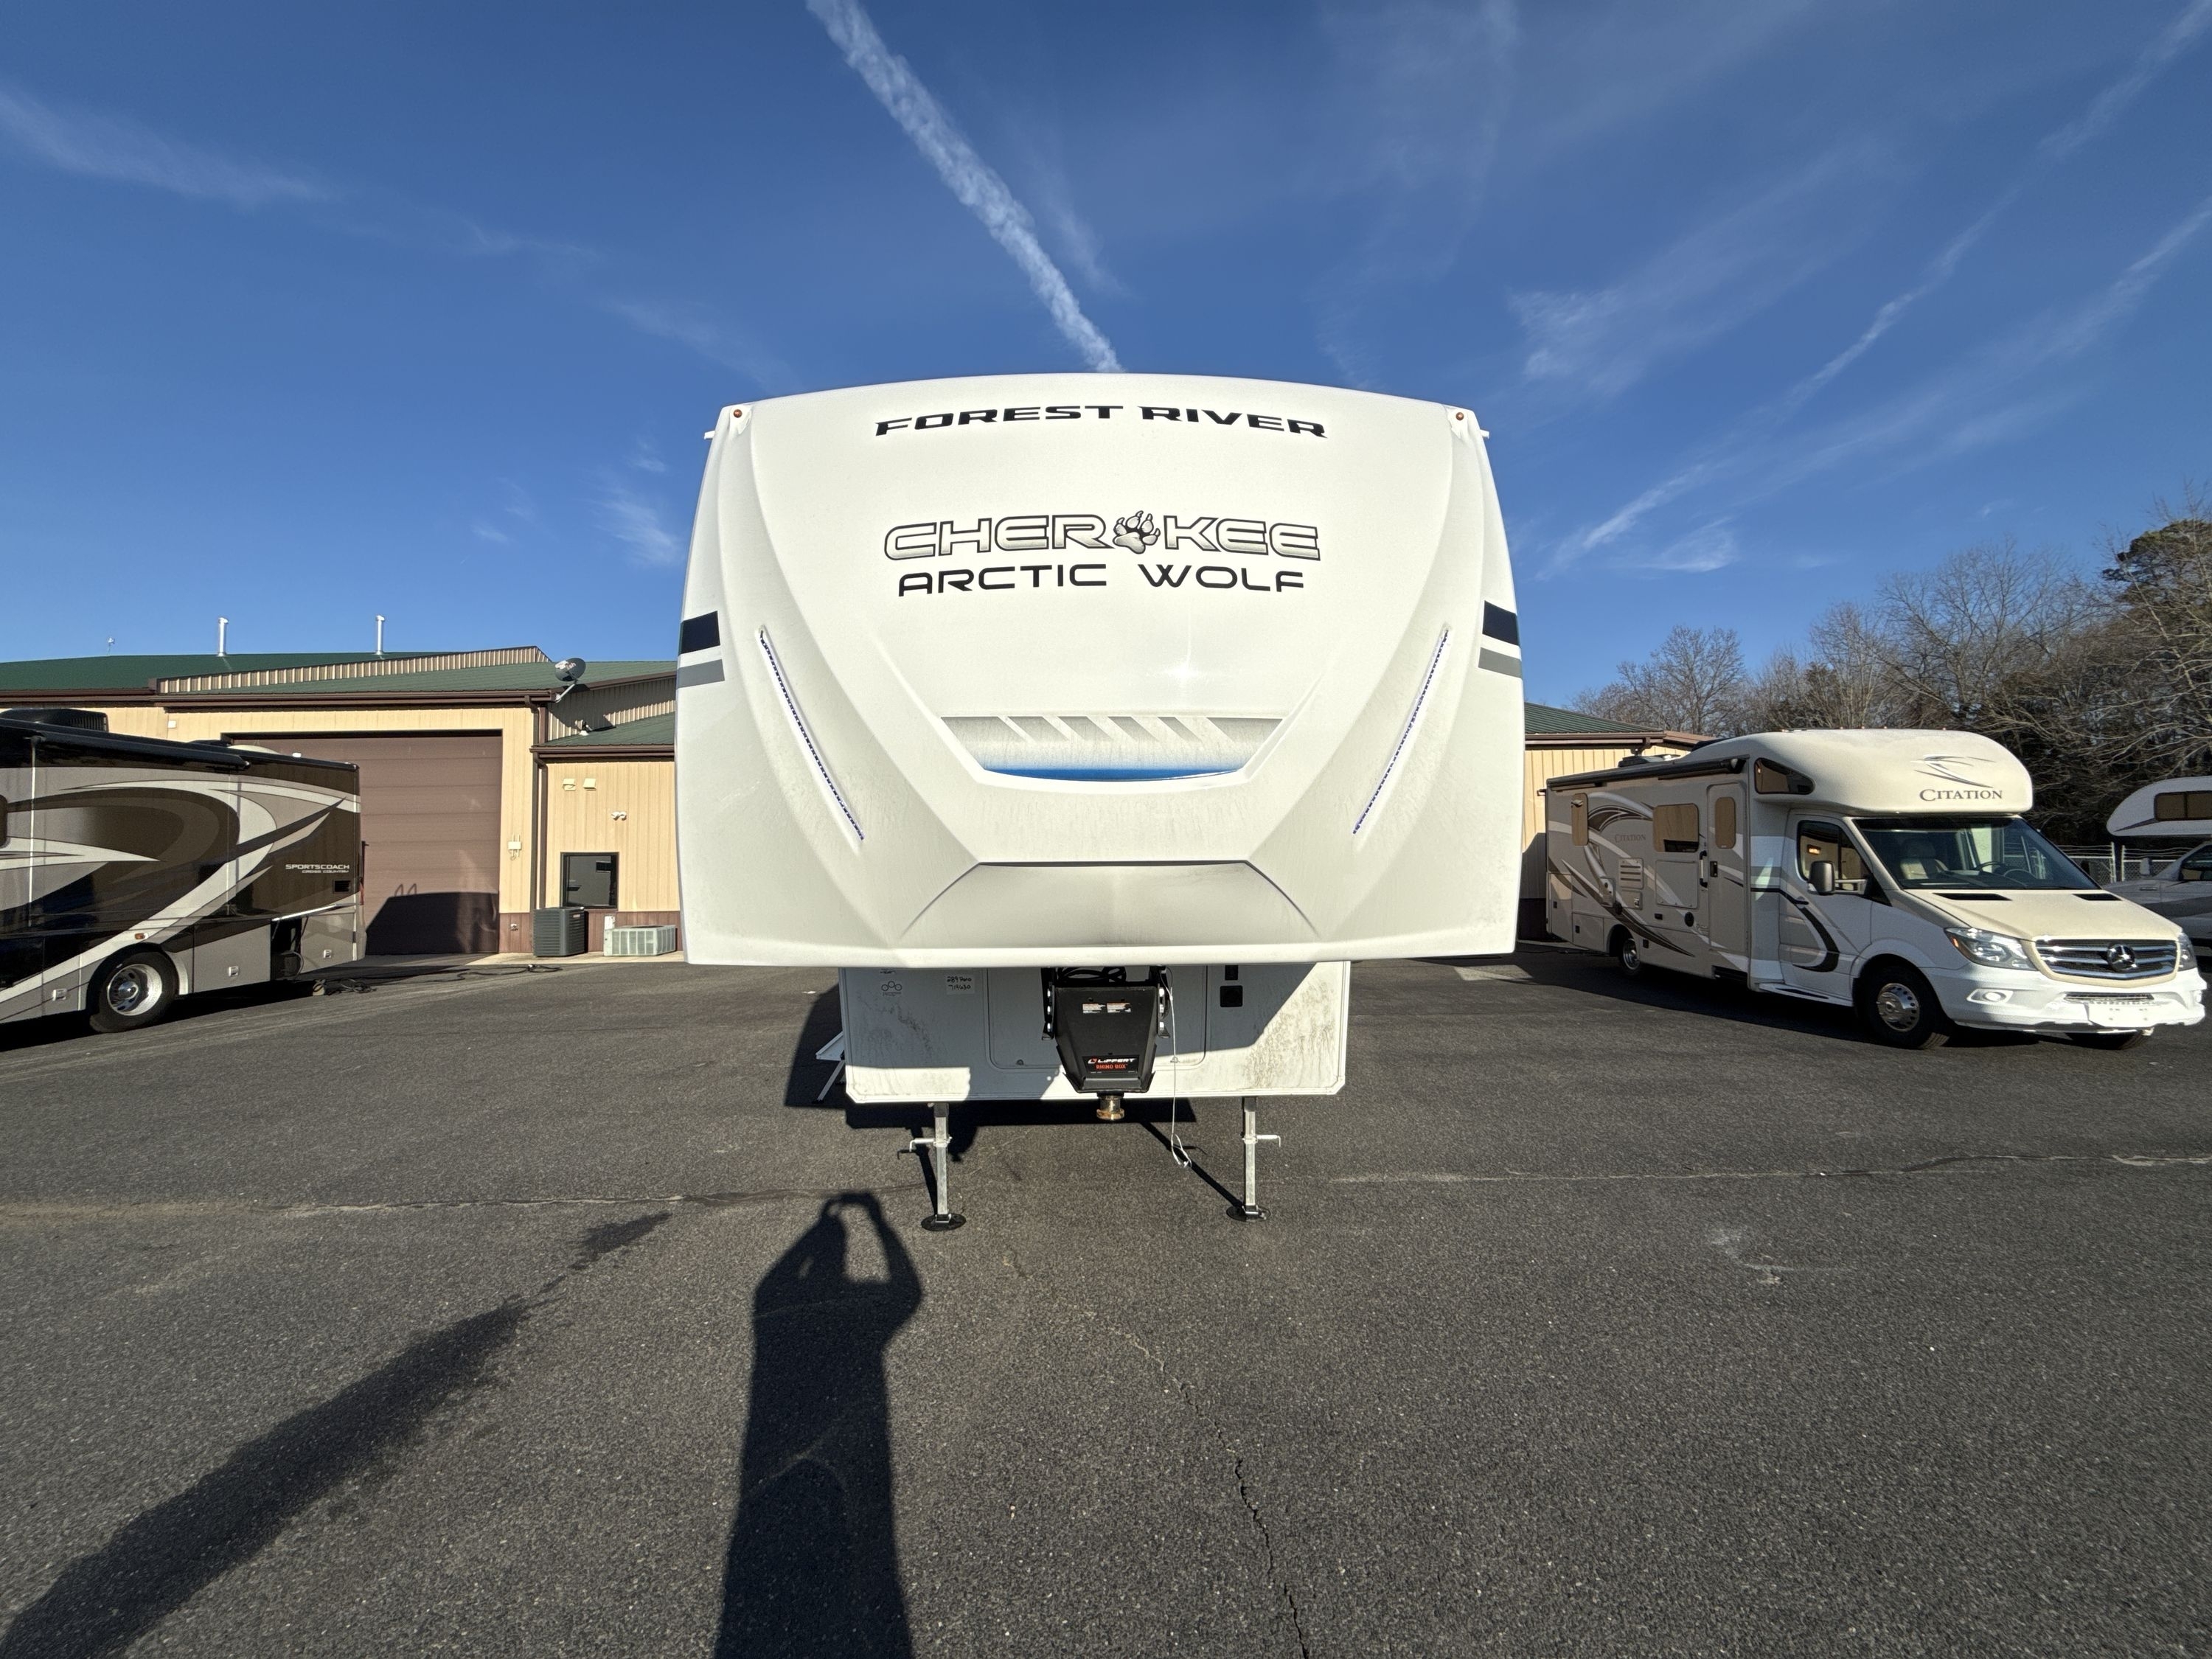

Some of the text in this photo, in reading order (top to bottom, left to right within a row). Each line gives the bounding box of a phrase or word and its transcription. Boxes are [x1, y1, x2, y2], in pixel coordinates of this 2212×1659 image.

[875, 406, 1327, 439] FOREST RIVER
[898, 563, 1304, 597] ARCTIC WOLF
